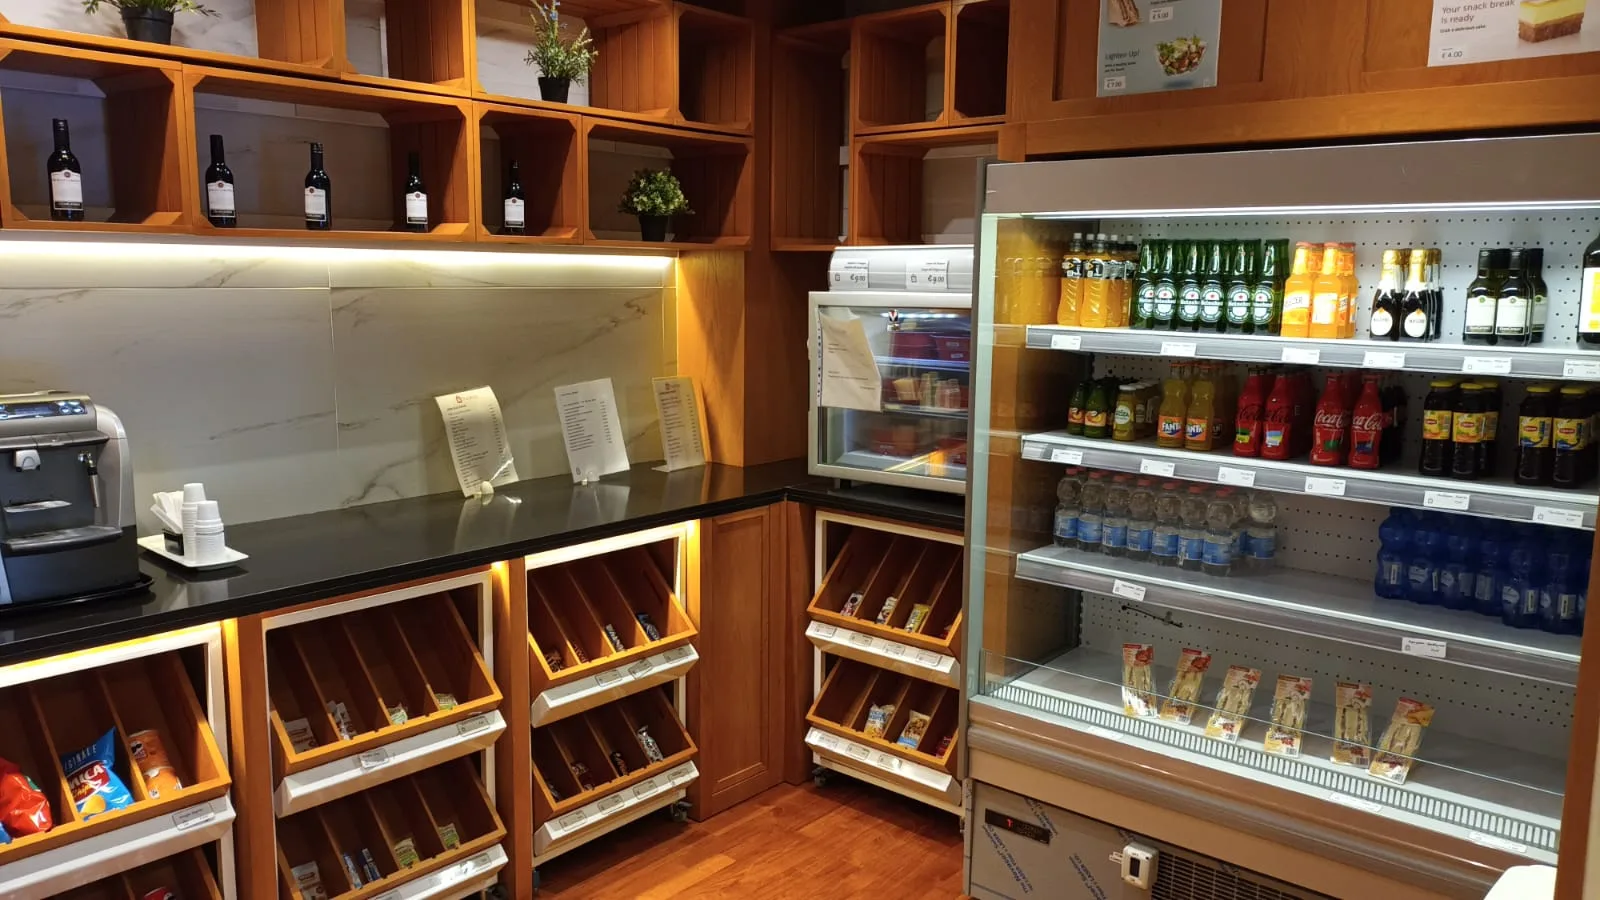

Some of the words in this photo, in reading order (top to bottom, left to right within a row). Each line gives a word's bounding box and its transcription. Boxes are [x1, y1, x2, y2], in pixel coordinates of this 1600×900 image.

[1442, 5, 1461, 14] Your
[1463, 3, 1487, 12] snack
[1489, 0, 1516, 9] break
[1450, 14, 1475, 23] ready
[69, 763, 105, 791] MICA
